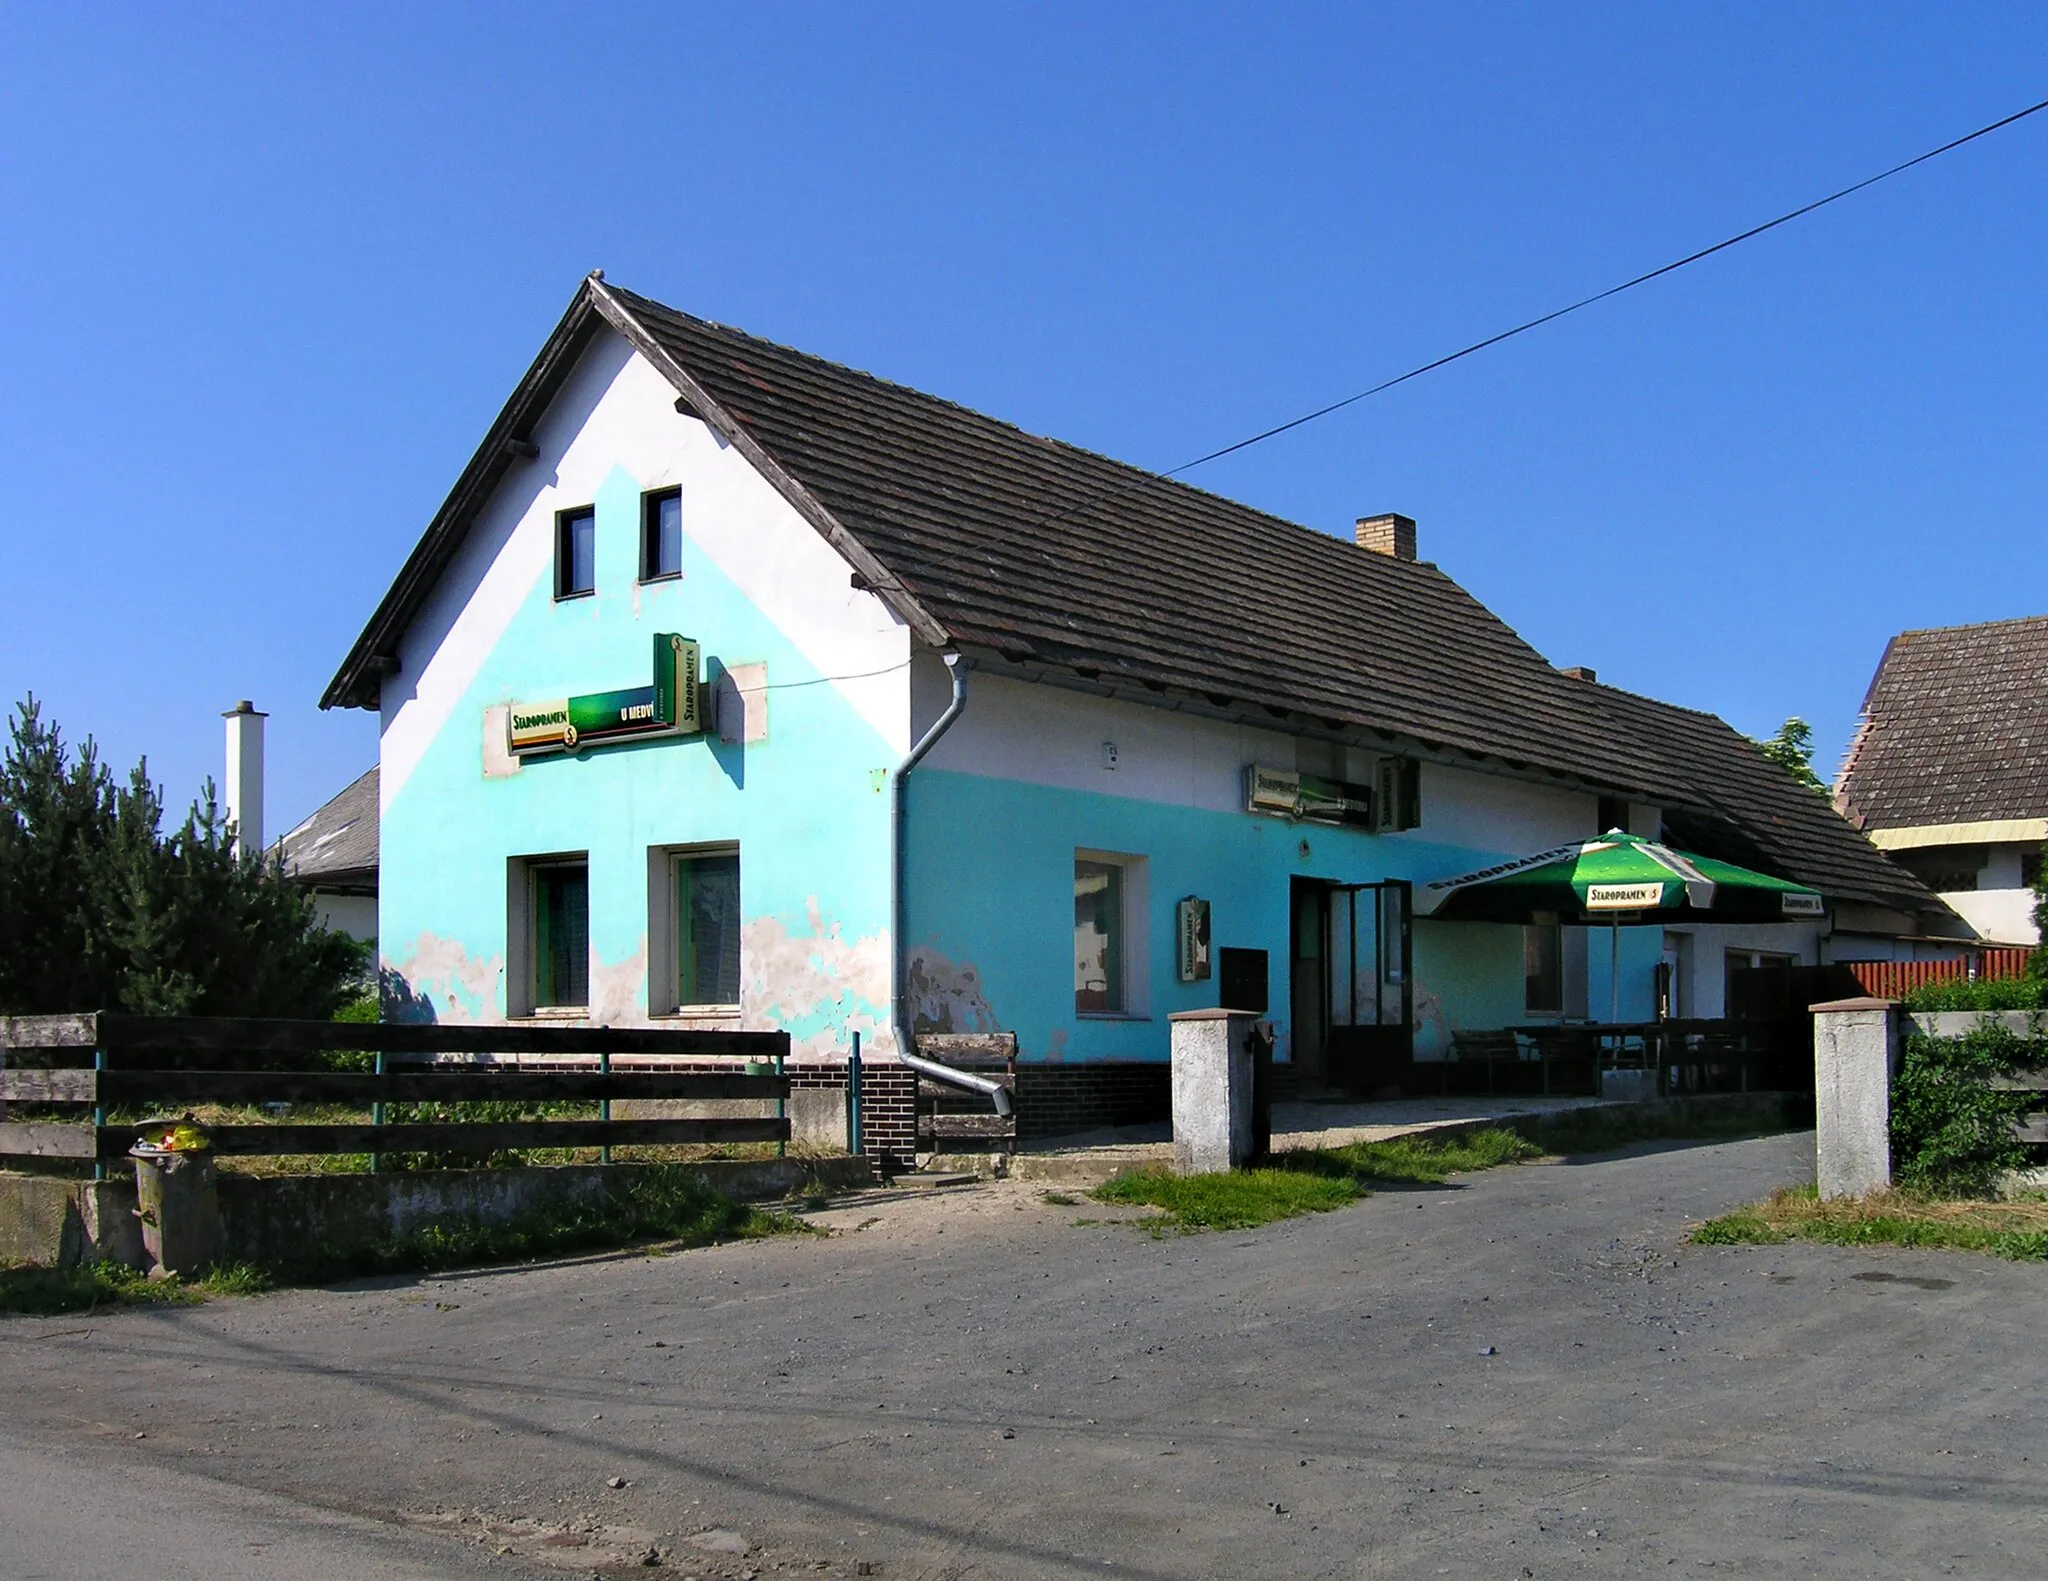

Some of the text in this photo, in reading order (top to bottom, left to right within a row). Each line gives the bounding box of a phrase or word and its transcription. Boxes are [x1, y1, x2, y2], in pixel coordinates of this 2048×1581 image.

[683, 649, 695, 721] STAROPRAMEN
[513, 710, 567, 730] STAROPRAMEN
[621, 707, 628, 721] U
[1427, 847, 1569, 890] STAROPRAMEN
[1591, 888, 1646, 901] STAROPRAMEN
[1184, 912, 1194, 975] STAROPRAMEN
